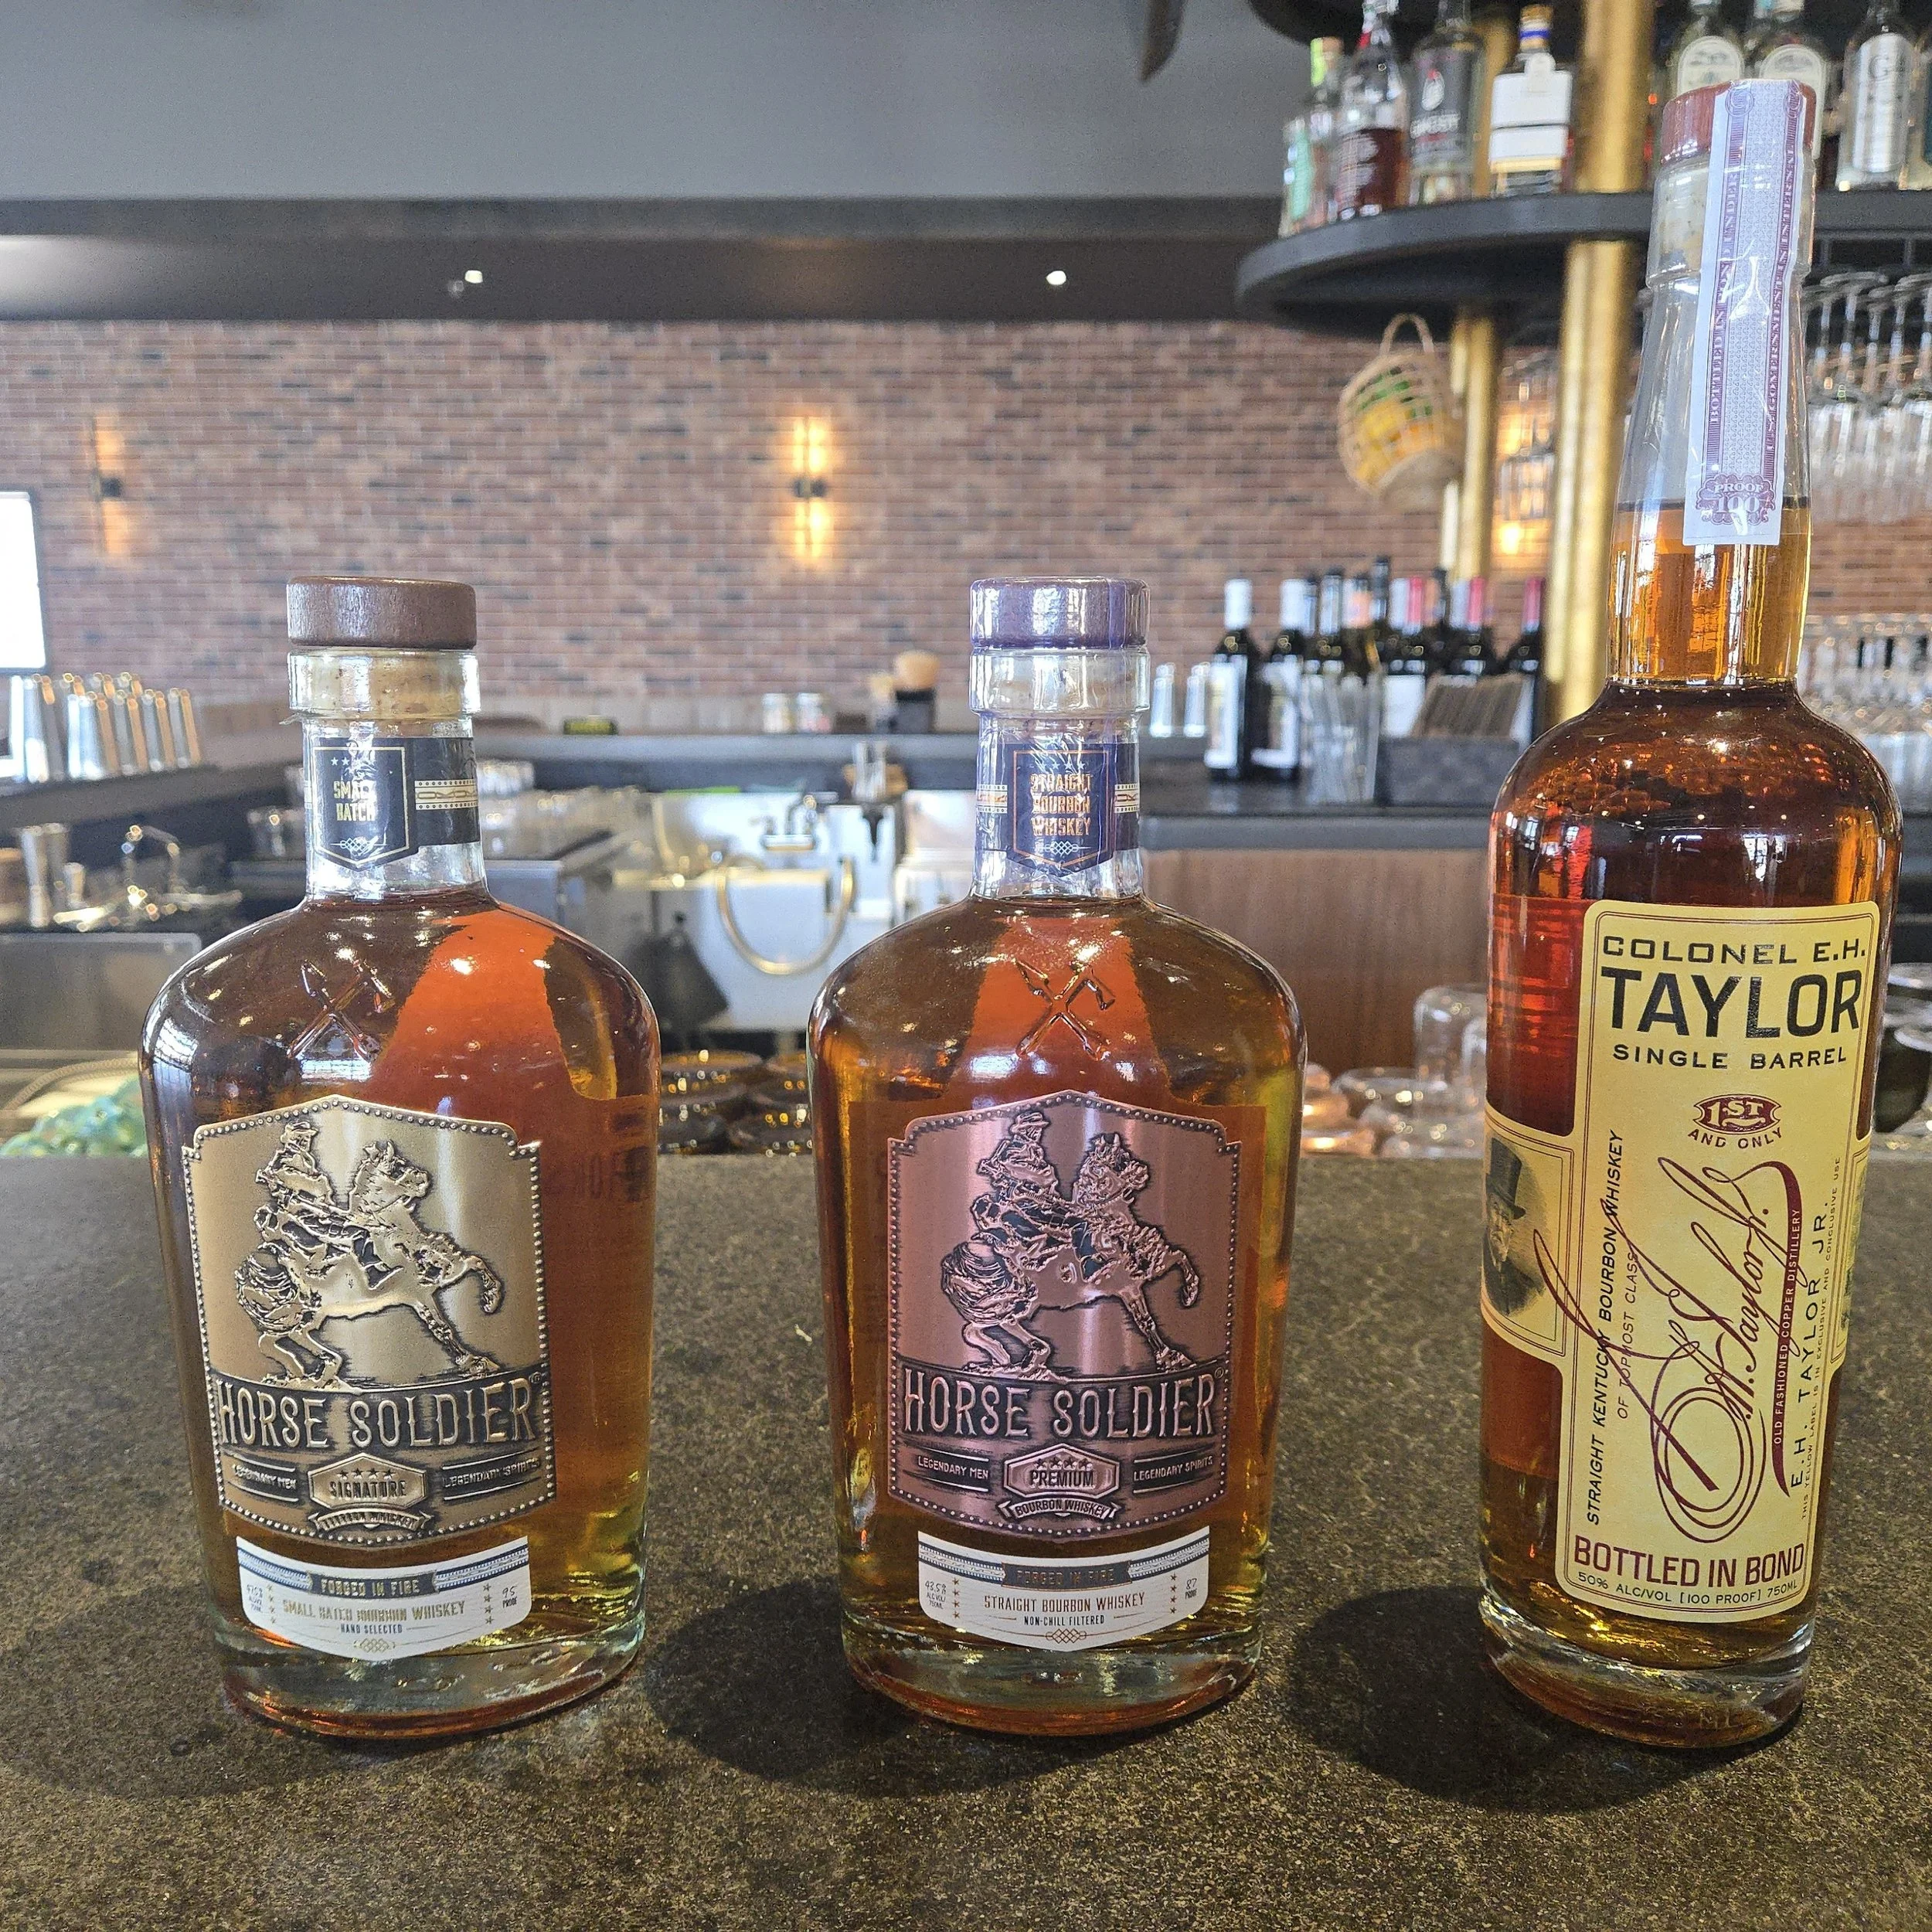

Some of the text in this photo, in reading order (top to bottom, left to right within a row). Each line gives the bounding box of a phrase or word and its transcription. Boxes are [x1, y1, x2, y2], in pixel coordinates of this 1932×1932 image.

[1715, 309, 1725, 329] IN
[1709, 336, 1723, 423] BOTTLED
[1714, 482, 1763, 494] PROOF
[1716, 495, 1760, 513] 100
[1029, 774, 1093, 792] STRAIGHT
[1032, 795, 1090, 814] BOURBON
[1031, 817, 1091, 836] WHISKEY
[1602, 936, 1866, 964] COLONEL E.H.
[1600, 966, 1862, 1039] TAYLOR
[1613, 1044, 1847, 1070] SINGLE BARREL
[1707, 1100, 1764, 1127] 1ST
[1688, 1127, 1782, 1149] AND ONLY
[1587, 1129, 1623, 1525] STRAIGHT KENTUCKY BOURBON WHISKEY
[1617, 1252, 1638, 1419] OF TOPMOST CLASS
[1774, 1209, 1801, 1444] OLD FASHIONED COPPER DISTILLERY
[1804, 1444, 1813, 1488] YELLOW
[1817, 1298, 1826, 1359] EXCLUSIVE
[1825, 1187, 1838, 1261] CONCLUSIVE
[1791, 1202, 1828, 1488] E.H. TAYLOR JR.
[216, 1376, 537, 1448] HORSE SOLDIER
[903, 1367, 1216, 1439] HORSE SOLDIER
[917, 1455, 989, 1480] LEGENDARY MEN
[1133, 1455, 1213, 1481] LEGENDARY SPIRITS
[329, 1480, 407, 1499] SIGNATURE
[1029, 1470, 1094, 1488] PREMIUM
[1015, 1499, 1108, 1519] BOURBON WHISKEY
[1574, 1534, 1804, 1588] BOTTLED IN BOND
[502, 1585, 517, 1598] 95
[925, 1580, 947, 1594] 43.5%
[1185, 1578, 1198, 1590] 87
[1577, 1571, 1609, 1590] 50%
[1616, 1583, 1672, 1603] ALC/VOL
[1767, 1583, 1798, 1599] 750ML
[411, 1600, 466, 1621] WHISKEY
[984, 1592, 1145, 1613] STRAIGHT BOURBON WHISKEY
[341, 1623, 403, 1634] HAND SELECTED
[1024, 1614, 1105, 1627] NON-CHILL FILTERED
